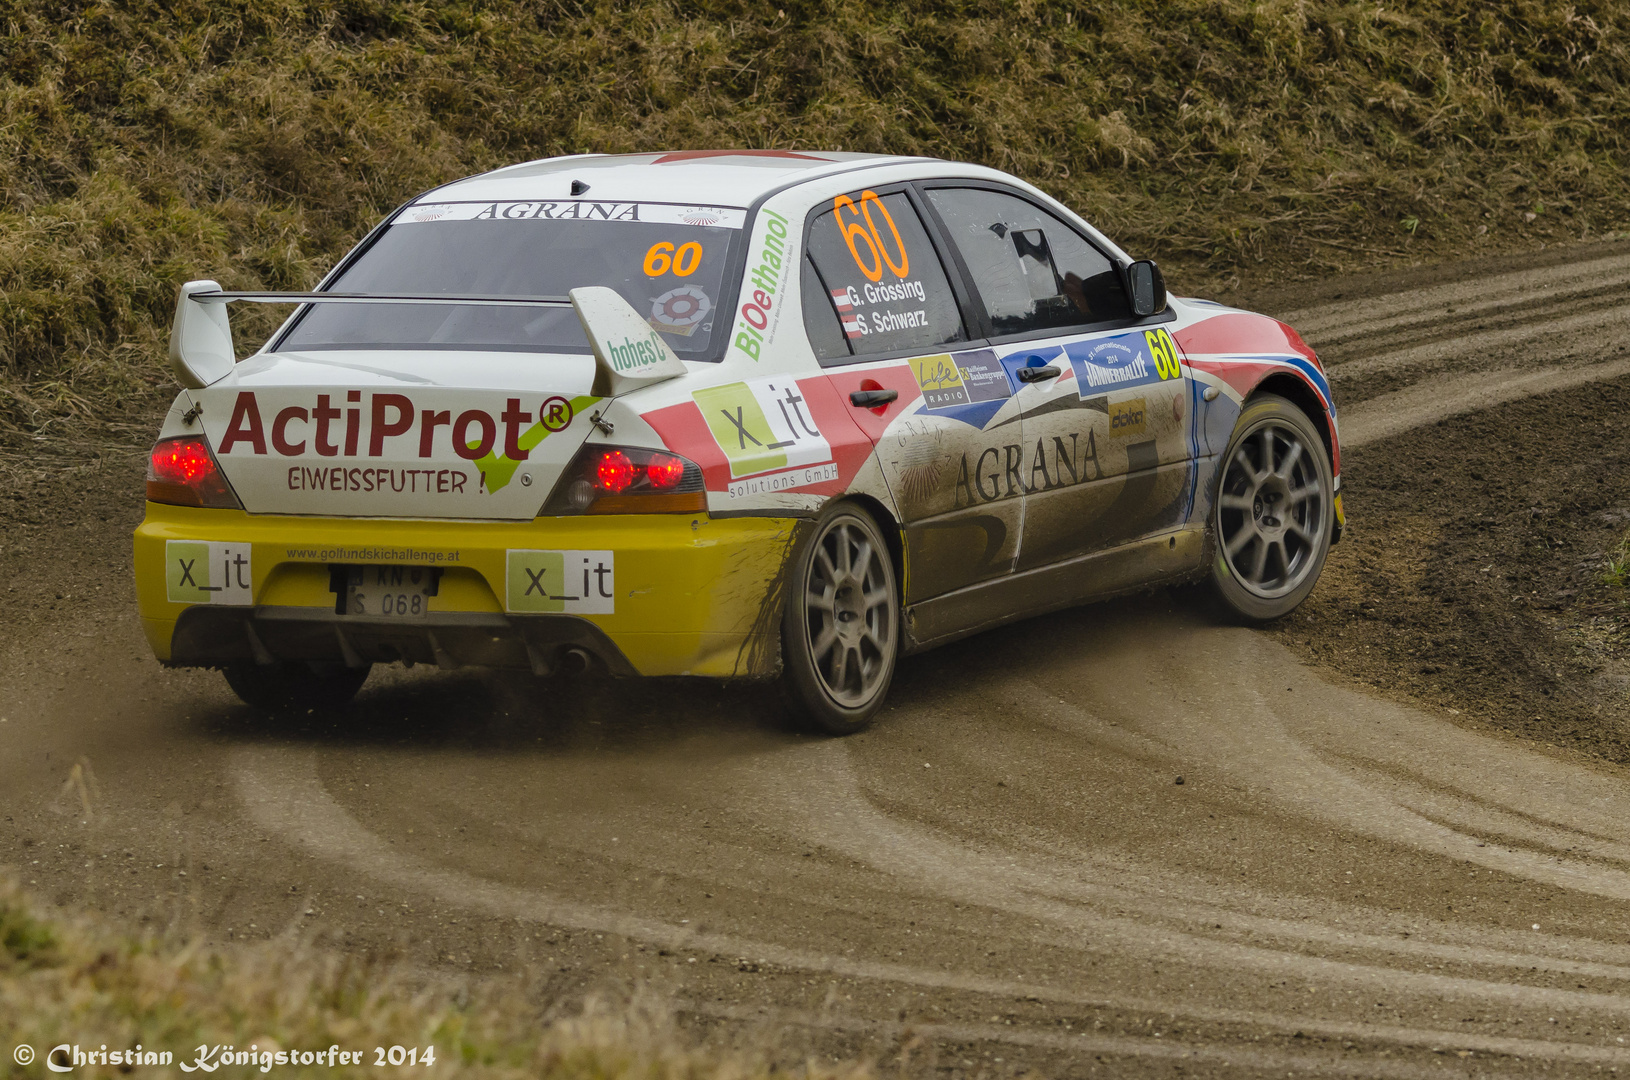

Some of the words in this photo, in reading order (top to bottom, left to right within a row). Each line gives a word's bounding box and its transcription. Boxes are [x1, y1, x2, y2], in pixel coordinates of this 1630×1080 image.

[470, 202, 641, 221] AGRANA
[833, 190, 909, 282] 60
[643, 241, 703, 277] 60
[735, 208, 789, 362] BiOethanol
[846, 285, 865, 307] G.
[864, 279, 926, 303] Grössing
[856, 314, 873, 335] S.
[875, 310, 929, 332] Schwarz
[1144, 328, 1181, 381] 60
[929, 391, 963, 404] RADIO
[1112, 406, 1144, 429] doka
[288, 466, 468, 494] EIWEISSFUTTER
[729, 475, 796, 499] solutions
[805, 463, 839, 483] GmbH
[954, 427, 1103, 509] AGRANA
[286, 548, 460, 565] www.golfundskichallenge.at
[382, 593, 422, 615] 068
